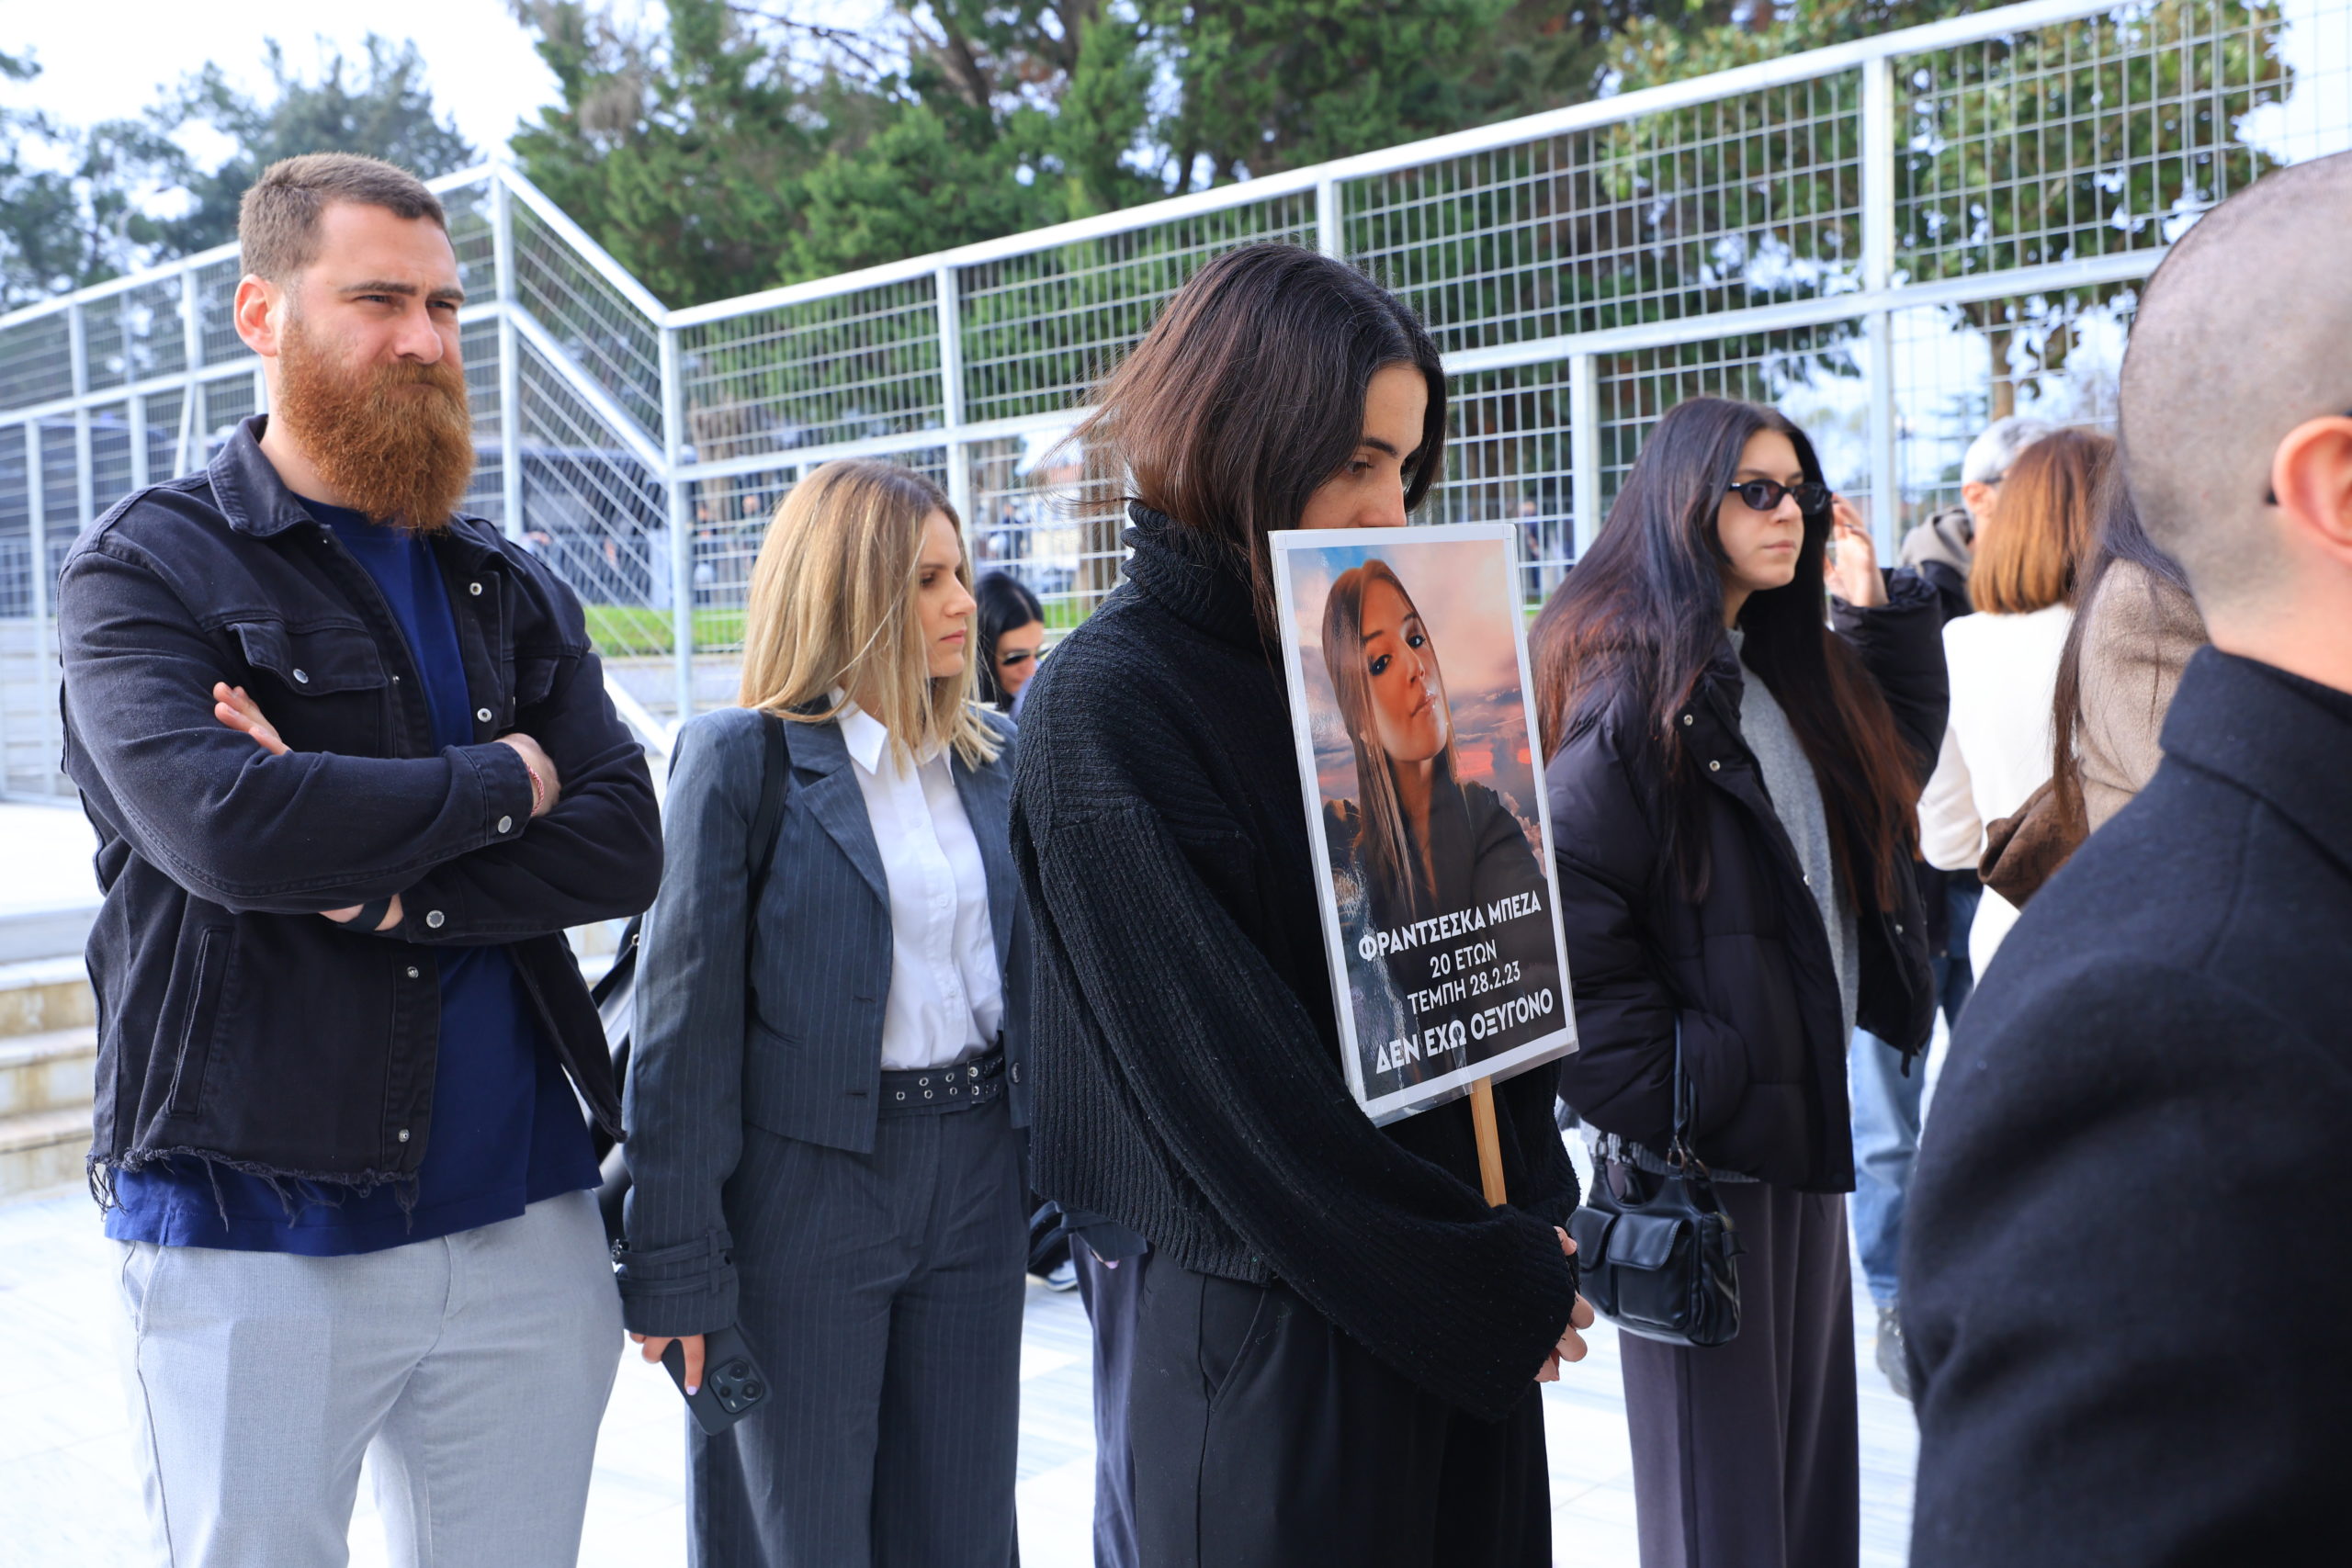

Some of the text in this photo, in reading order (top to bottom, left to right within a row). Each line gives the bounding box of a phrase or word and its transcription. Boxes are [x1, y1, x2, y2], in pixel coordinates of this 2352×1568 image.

[1358, 890, 1542, 962] ΦΡΑΝΤΣΕΣΚΑ ΜΠΕΖΑ
[1408, 961, 1521, 1014] ΤΕΜΠΗ 28.2.23
[1430, 939, 1498, 978] 20 ΕΤΩΝ
[1376, 987, 1554, 1074] ΔΕΝ ΕΧΩ ΟΞΥΓΟΝΟ
